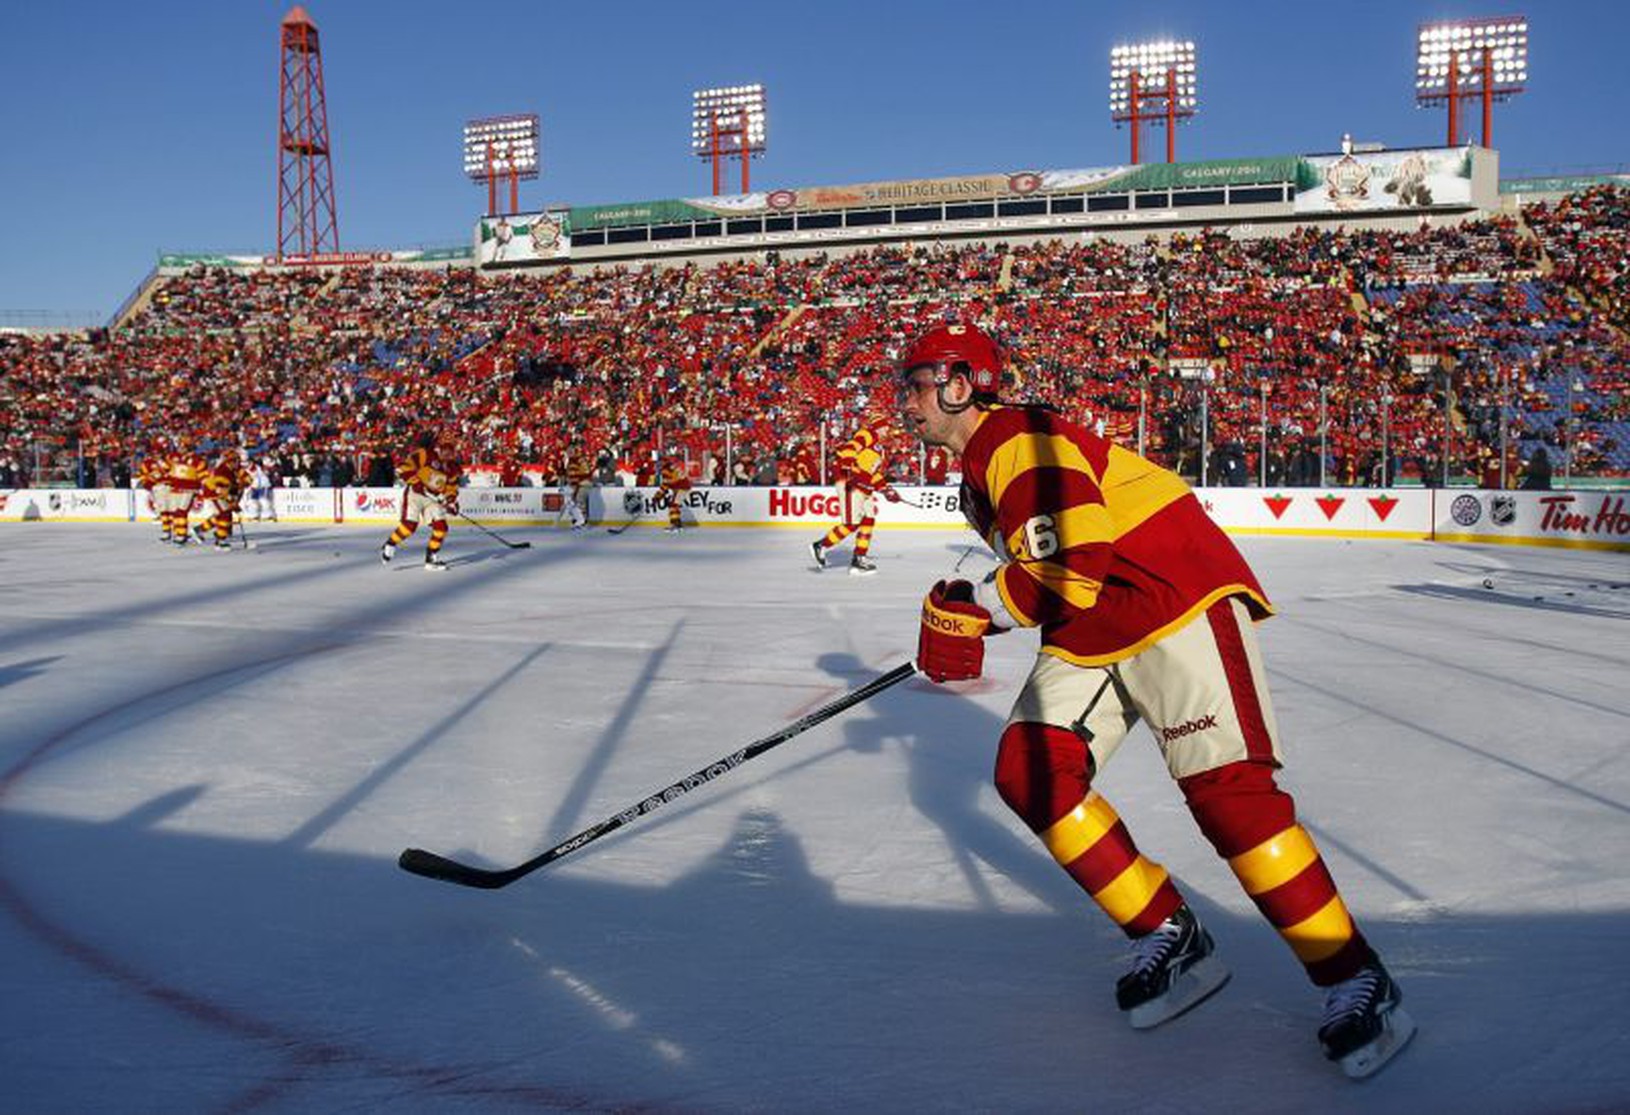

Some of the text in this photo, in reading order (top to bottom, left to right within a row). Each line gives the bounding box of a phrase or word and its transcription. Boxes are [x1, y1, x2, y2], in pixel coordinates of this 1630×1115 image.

[1183, 166, 1231, 178] CALGARY
[880, 183, 938, 199] HERITAGE
[940, 179, 991, 196] CLASSIC
[644, 490, 709, 514] HOEY
[708, 501, 732, 514] FOR
[1540, 496, 1590, 533] Tim
[1162, 715, 1218, 742] Reebok
